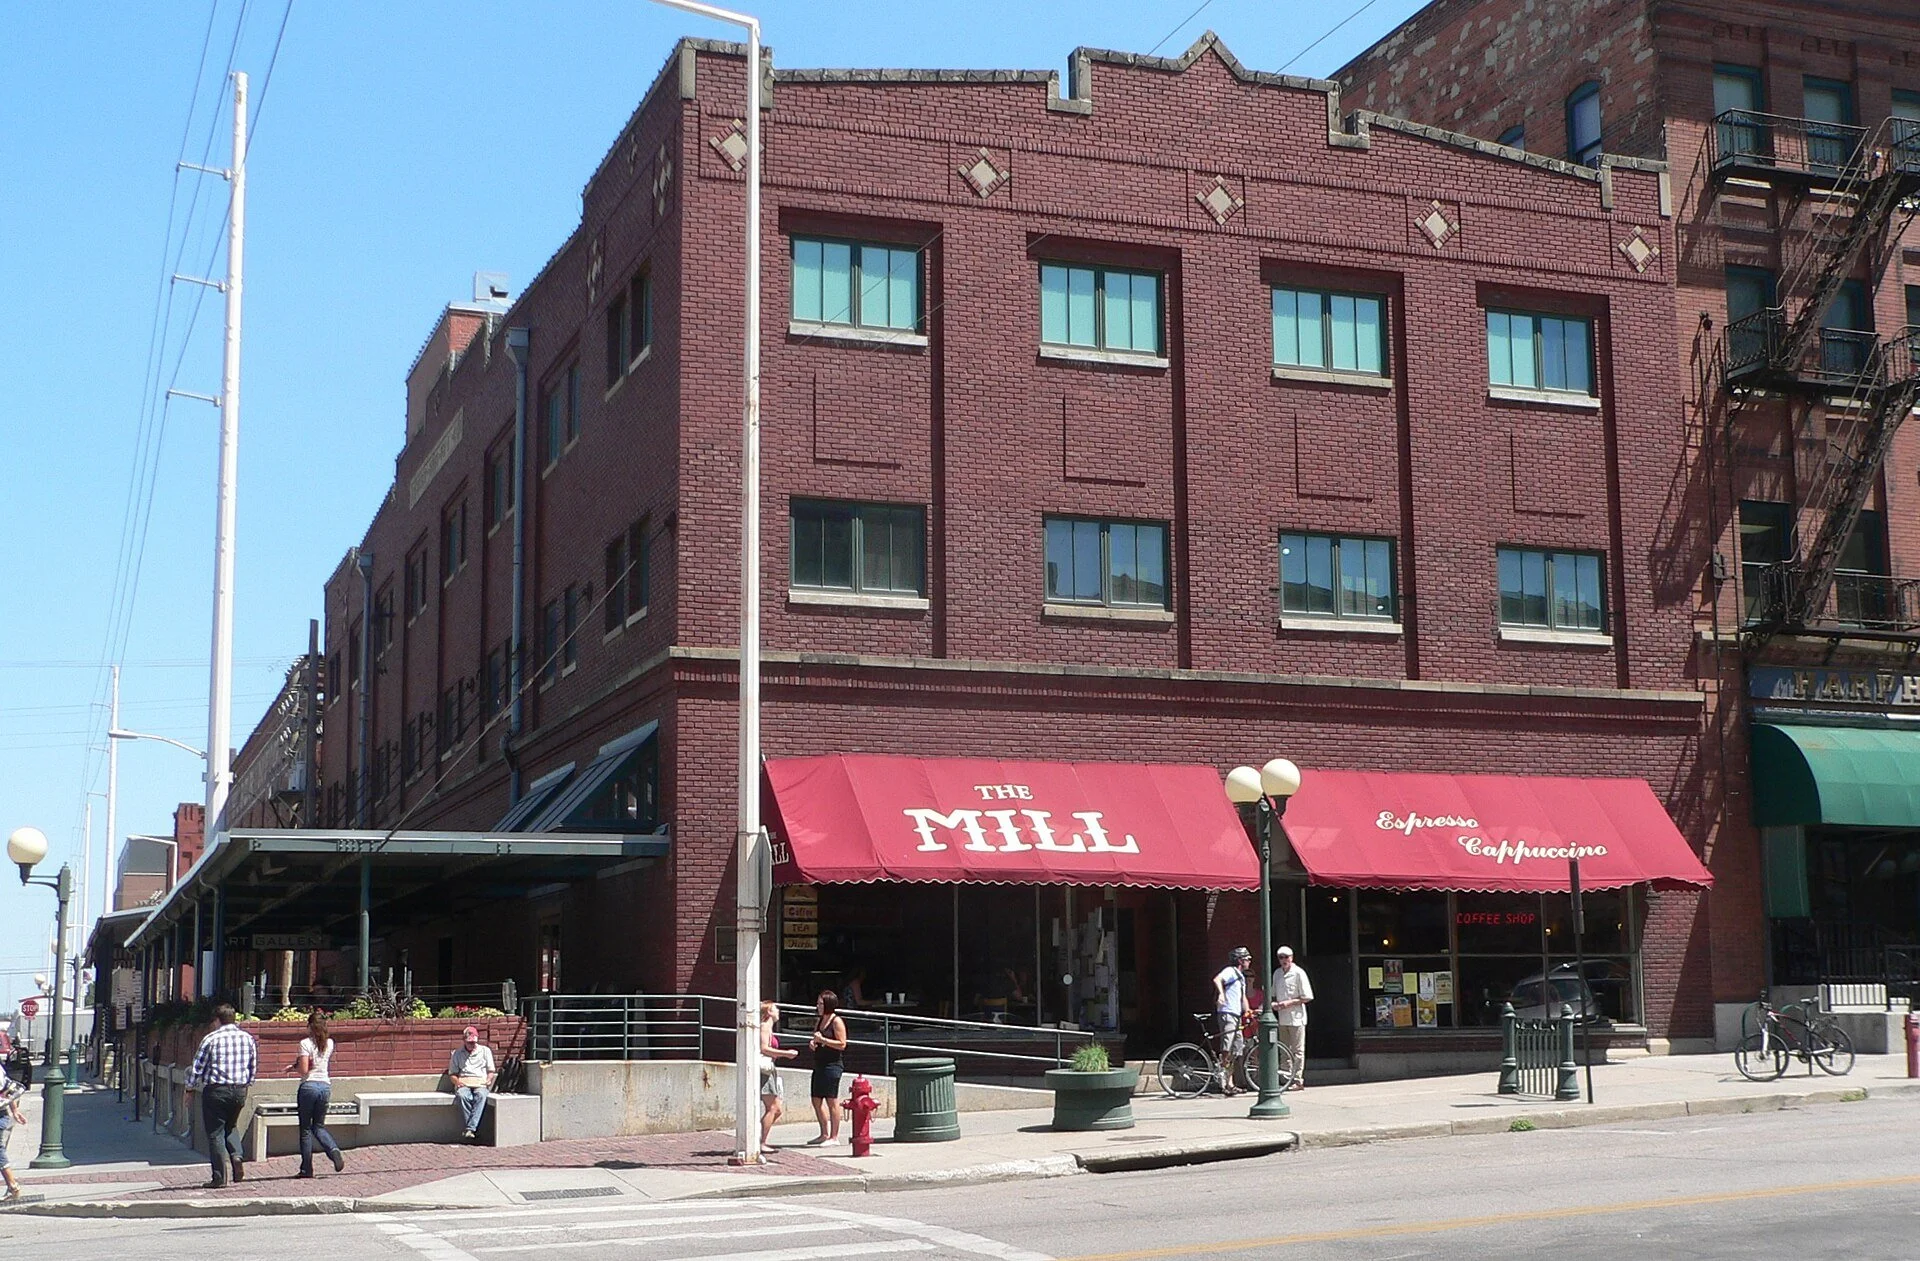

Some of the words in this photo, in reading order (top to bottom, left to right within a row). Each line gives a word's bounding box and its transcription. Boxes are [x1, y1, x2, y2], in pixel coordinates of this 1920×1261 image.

[974, 784, 1034, 801] THE
[903, 808, 1140, 854] MILL
[1376, 811, 1479, 836] Espresso
[1458, 836, 1608, 864] Cappuccino
[792, 923, 810, 932] TEA
[1456, 912, 1502, 926] COFFEE
[1505, 912, 1536, 926] SHOP
[22, 1004, 39, 1012] STOP
